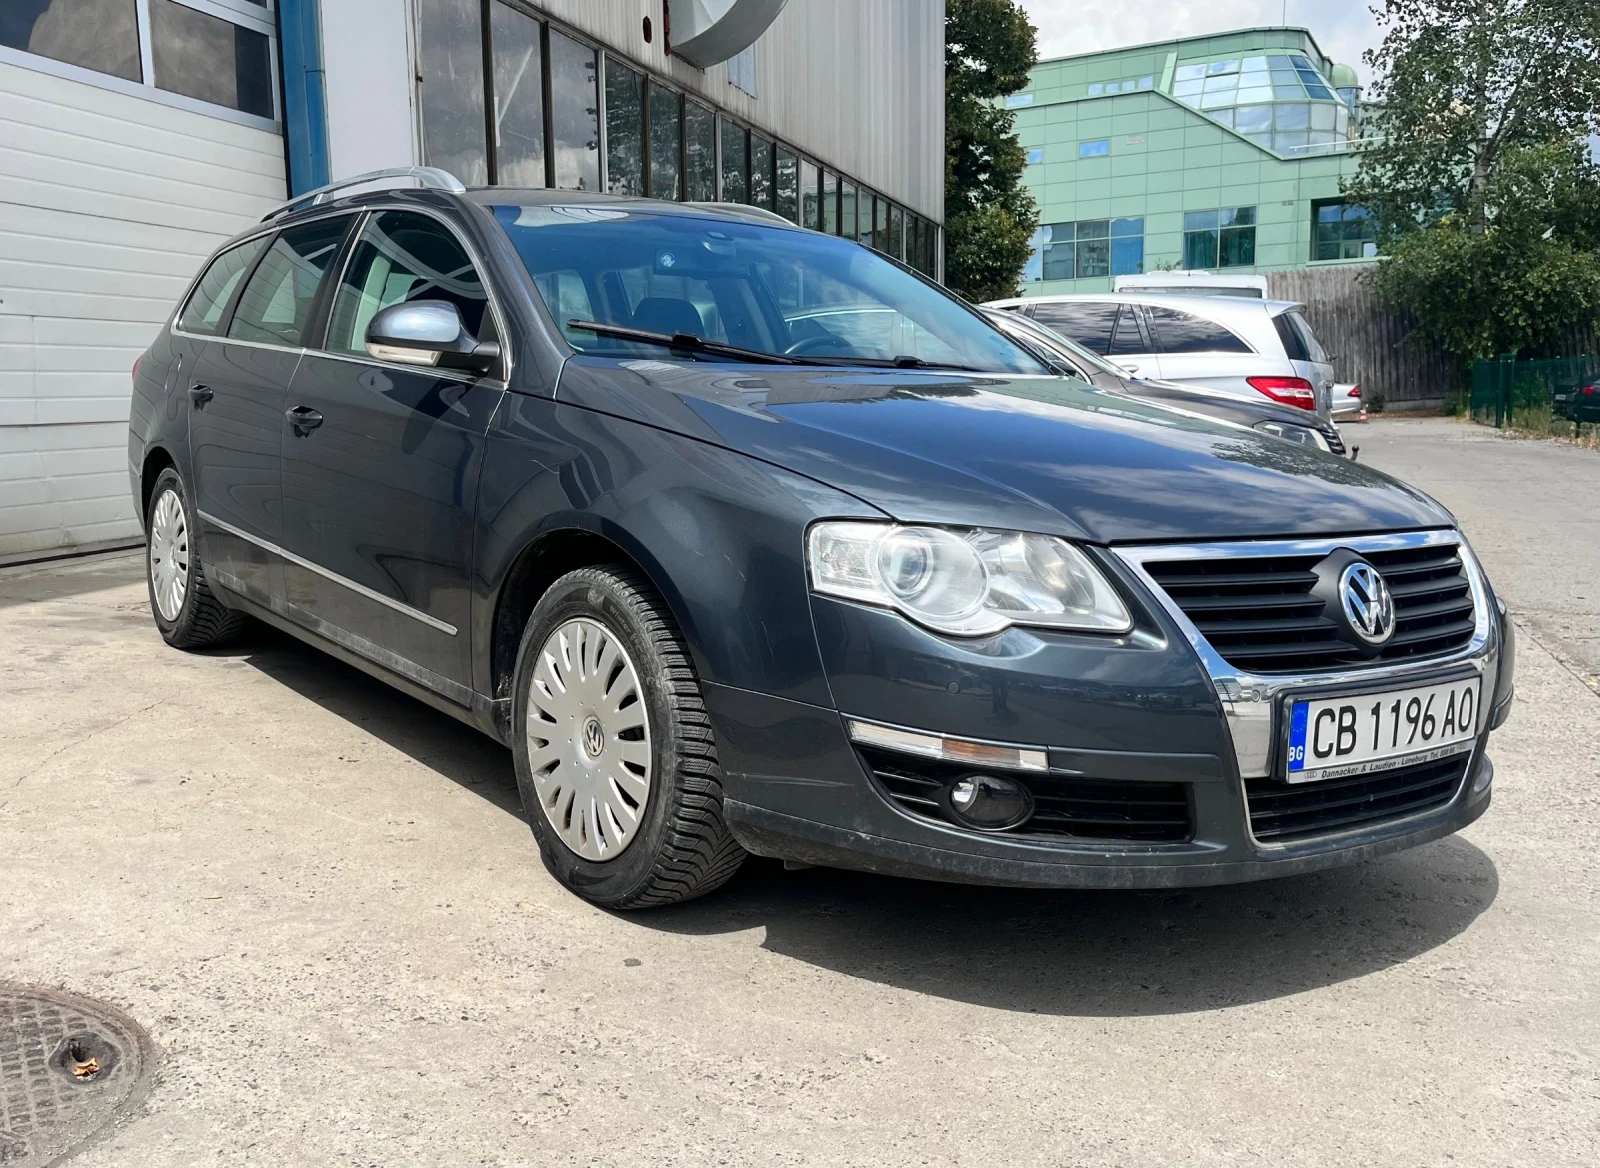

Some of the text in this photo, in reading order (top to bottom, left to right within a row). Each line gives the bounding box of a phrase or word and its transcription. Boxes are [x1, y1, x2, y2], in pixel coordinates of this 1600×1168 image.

[1312, 687, 1473, 759] CB 1196 AO
[1289, 745, 1304, 762] BG
[1321, 765, 1359, 779] Dannacker
[1369, 760, 1397, 772] Laudien
